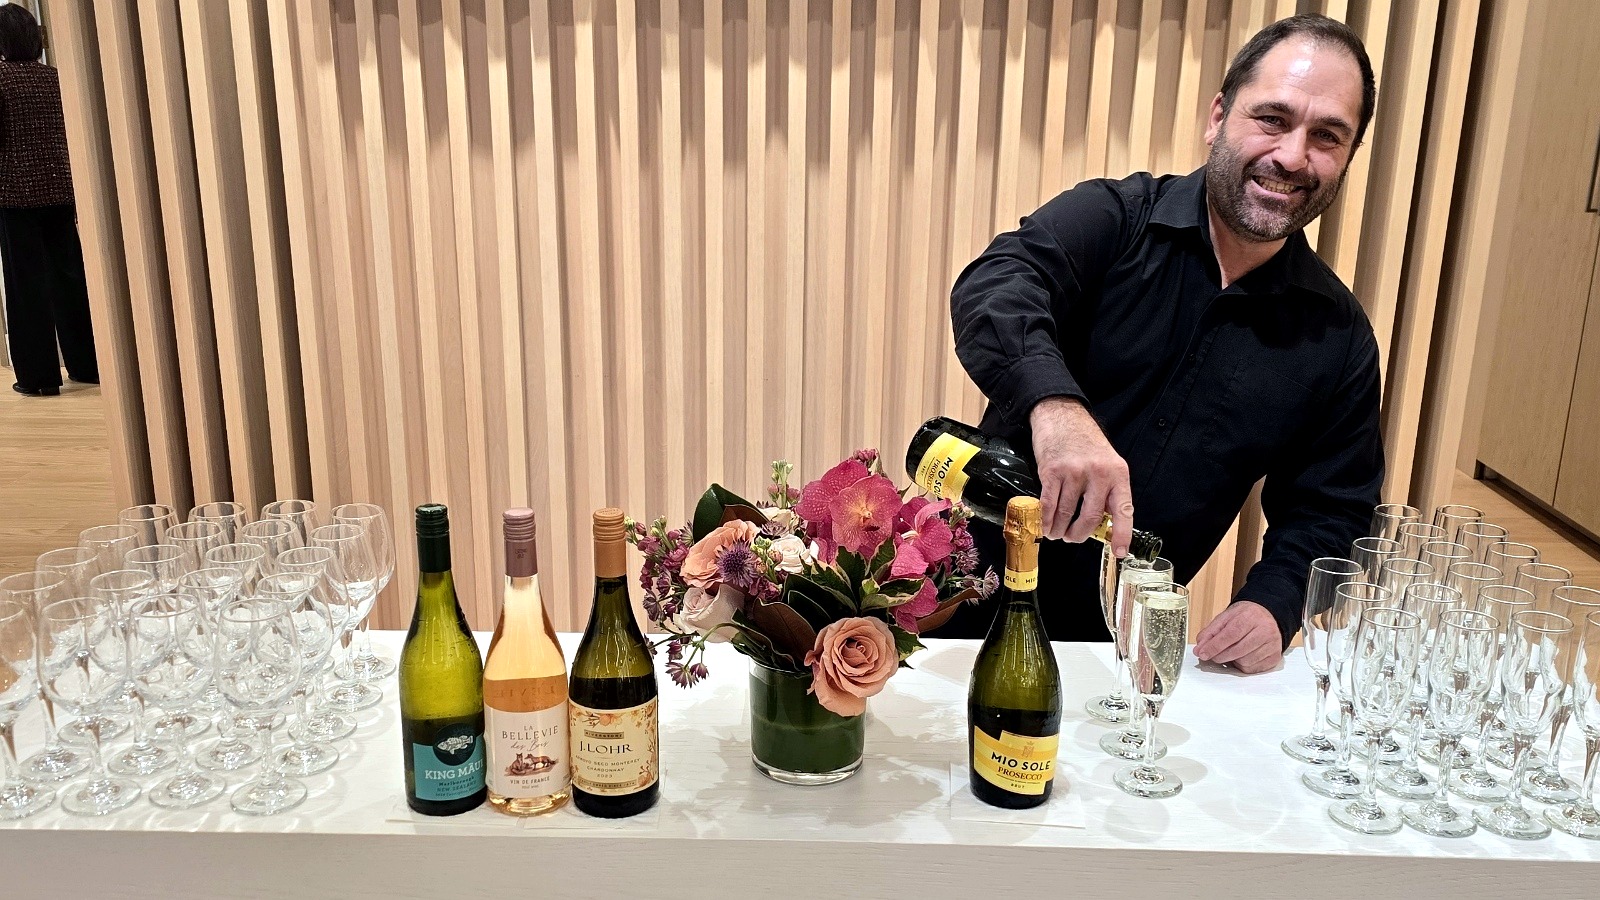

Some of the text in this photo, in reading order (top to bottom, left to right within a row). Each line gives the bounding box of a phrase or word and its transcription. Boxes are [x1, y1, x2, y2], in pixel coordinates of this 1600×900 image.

[937, 456, 954, 479] MIO
[502, 725, 559, 740] BELLEVIE
[991, 752, 1051, 771] MIO SOLE
[425, 770, 455, 779] KING
[997, 766, 1043, 780] PROSECCO
